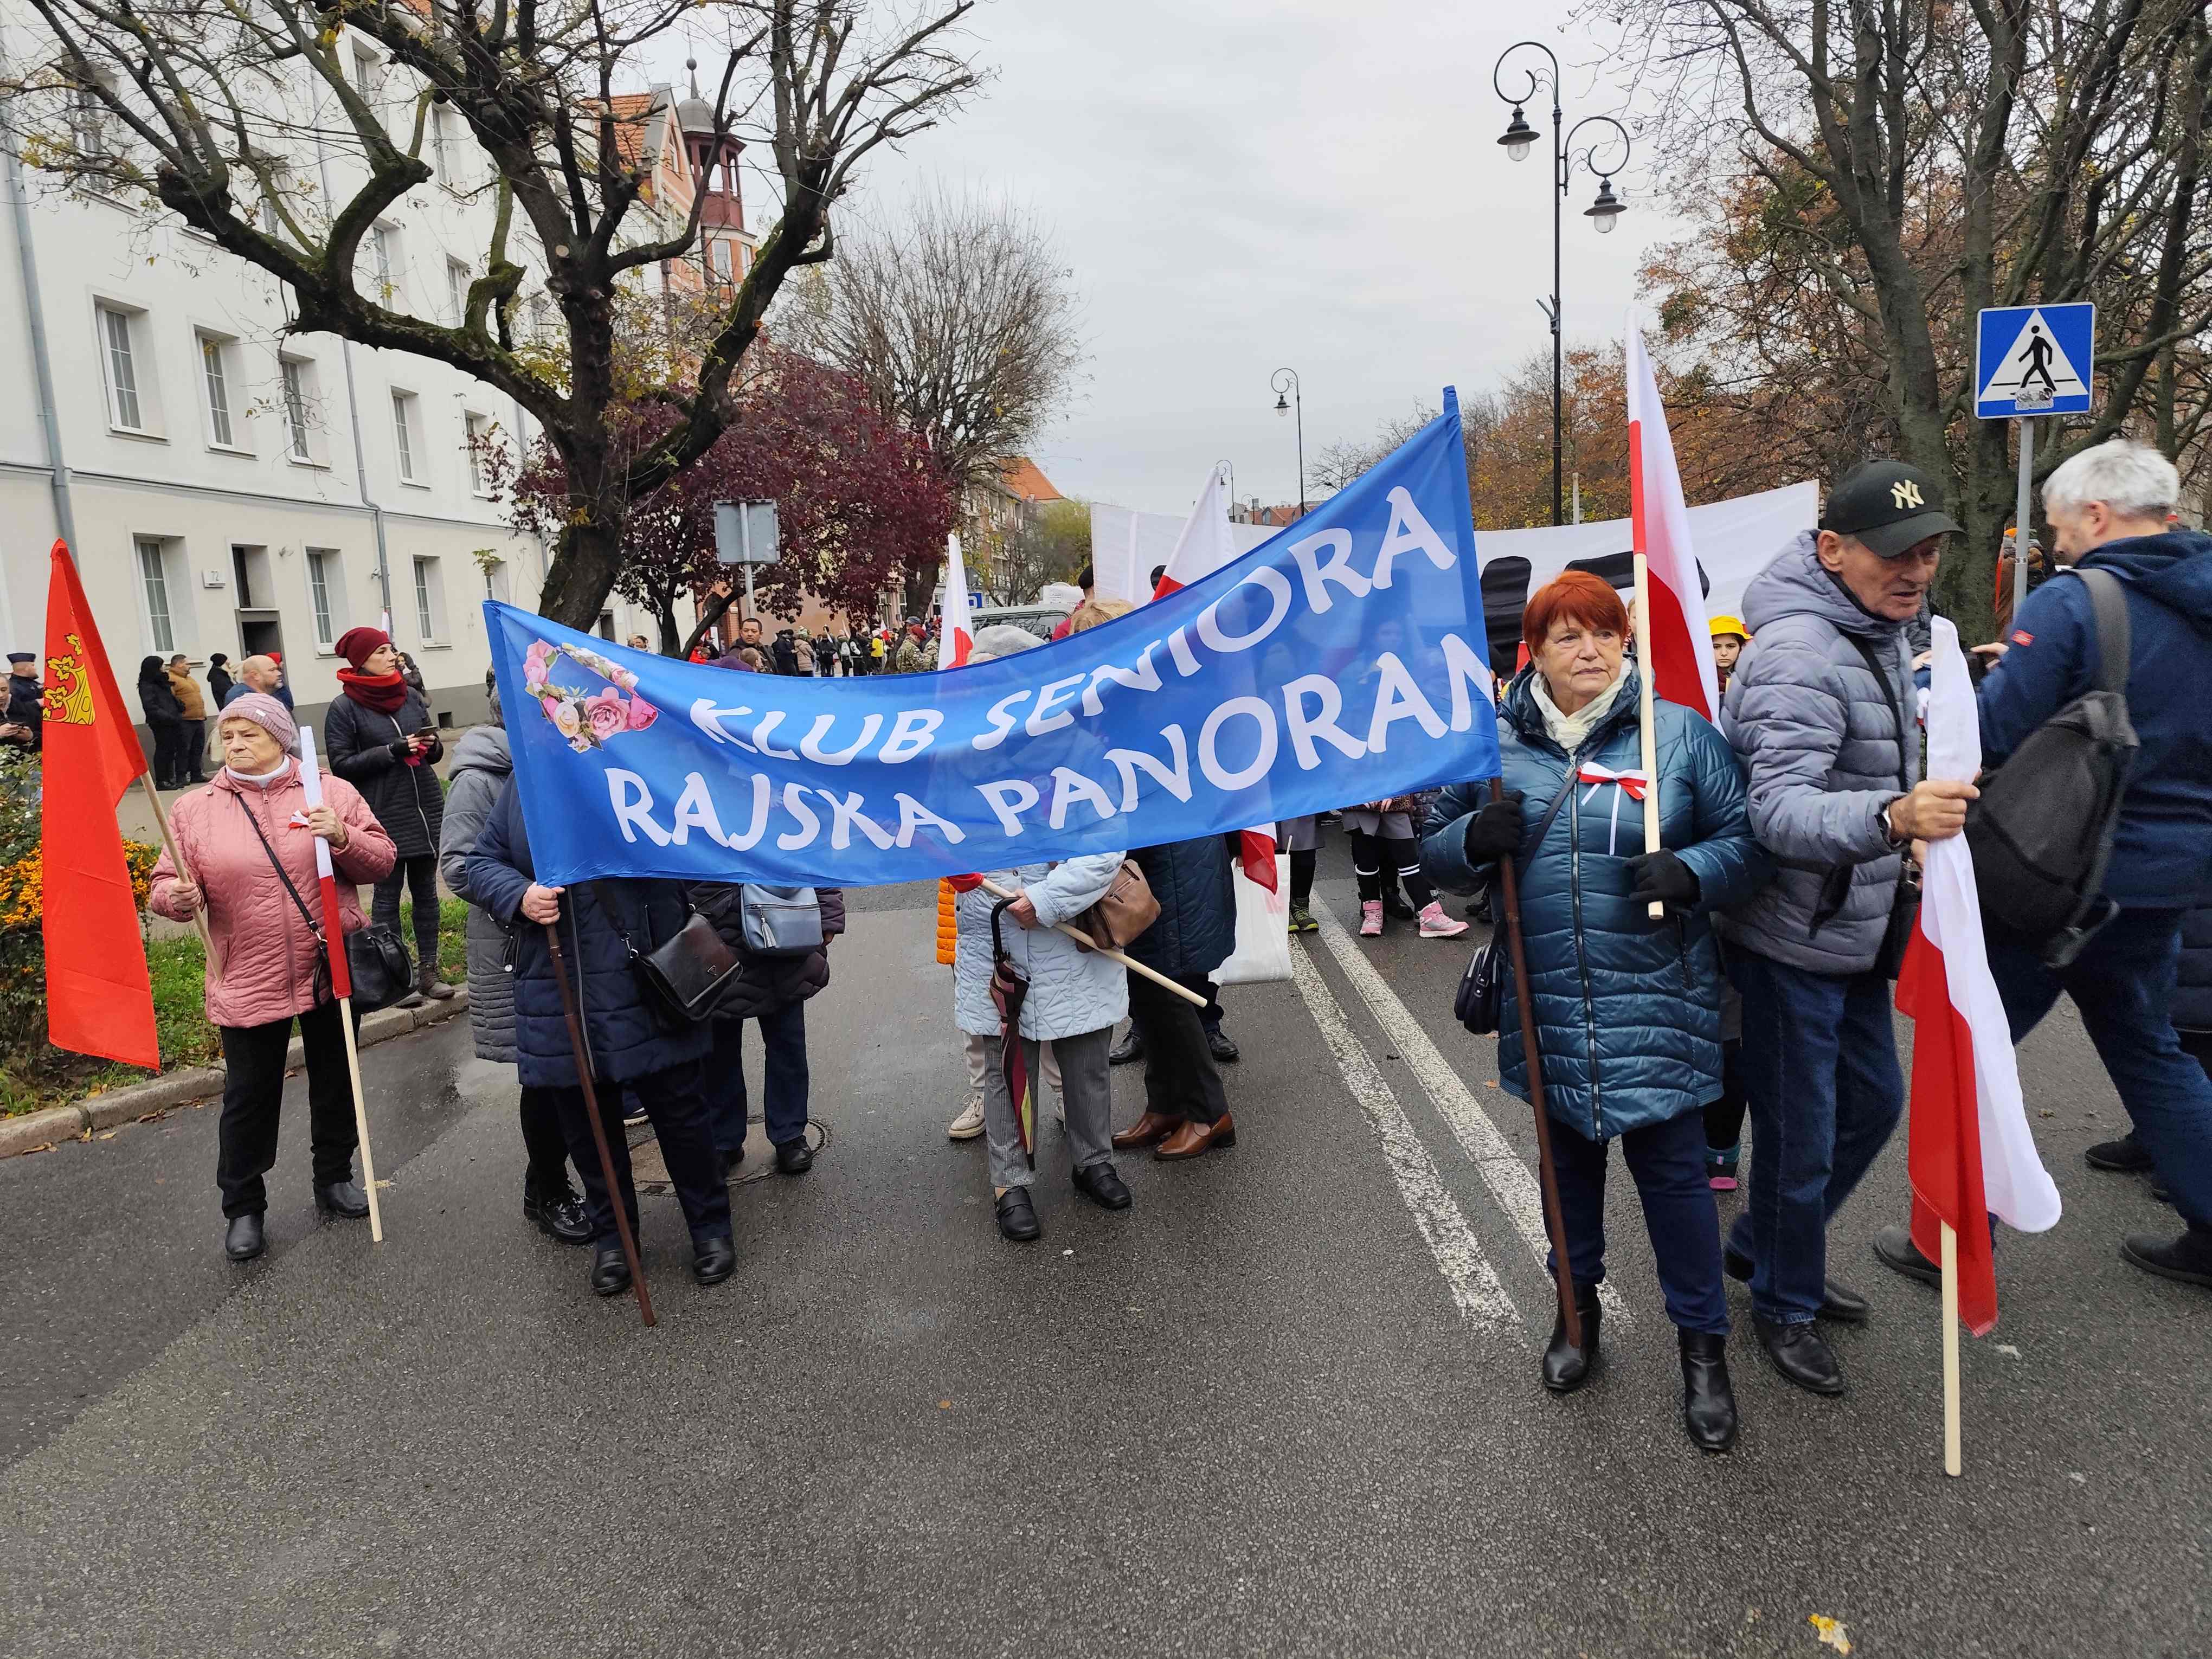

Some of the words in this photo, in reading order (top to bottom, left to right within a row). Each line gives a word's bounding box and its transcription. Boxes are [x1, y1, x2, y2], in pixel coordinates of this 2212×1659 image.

[1890, 479, 1925, 509] NY
[690, 698, 944, 765] KLUB
[972, 485, 1457, 751] SENIORA
[605, 768, 967, 852] RAJSKA
